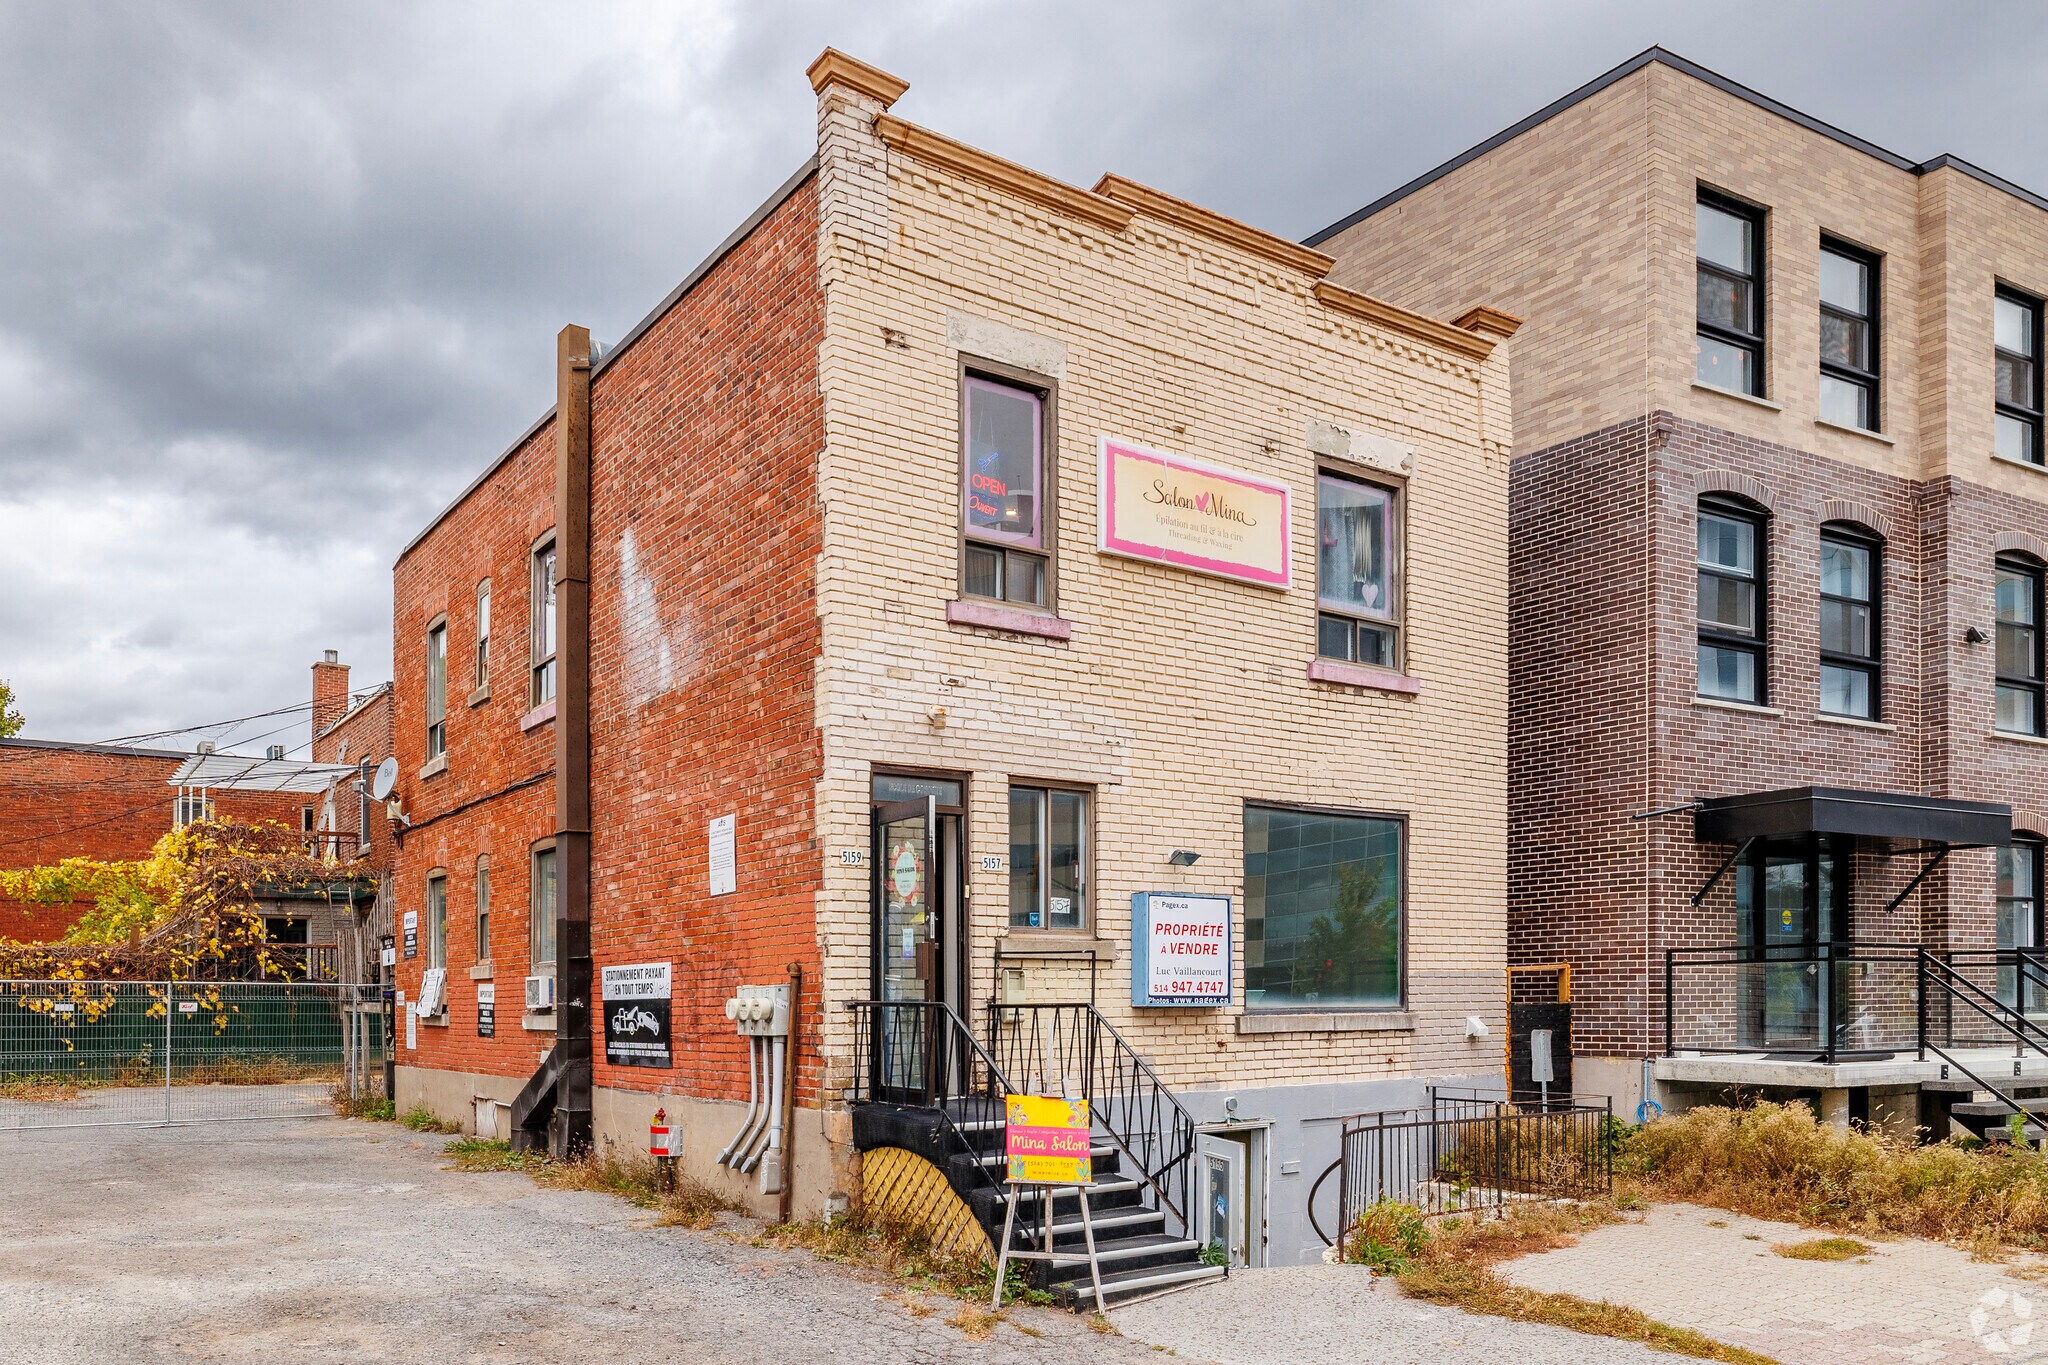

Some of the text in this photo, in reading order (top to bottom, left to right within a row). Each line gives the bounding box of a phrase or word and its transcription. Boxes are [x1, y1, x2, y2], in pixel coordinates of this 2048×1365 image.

[971, 473, 1006, 496] OPEN
[1143, 479, 1257, 526] Salon Mina
[1155, 512, 1189, 530] Épilation
[1189, 523, 1199, 533] au
[1200, 524, 1208, 534] fil
[1222, 529, 1229, 539] la
[1230, 531, 1244, 542] cire
[1168, 529, 1202, 544] Threading
[842, 851, 862, 864] 5159
[983, 857, 1001, 869] 5157
[1161, 901, 1188, 909] Pagex.ca
[1155, 922, 1223, 937] PROPRIÉTÉ
[1160, 942, 1218, 955] À VENDRE
[605, 967, 665, 981] STATIONNEMENT PAYANT
[1156, 966, 1222, 976] Luc Vaillancourt
[615, 983, 653, 995] EN TOUT TEMPS
[1153, 984, 1168, 993] 514
[1011, 1134, 1089, 1151] Mina Salon
[1209, 1157, 1224, 1171] 5155
